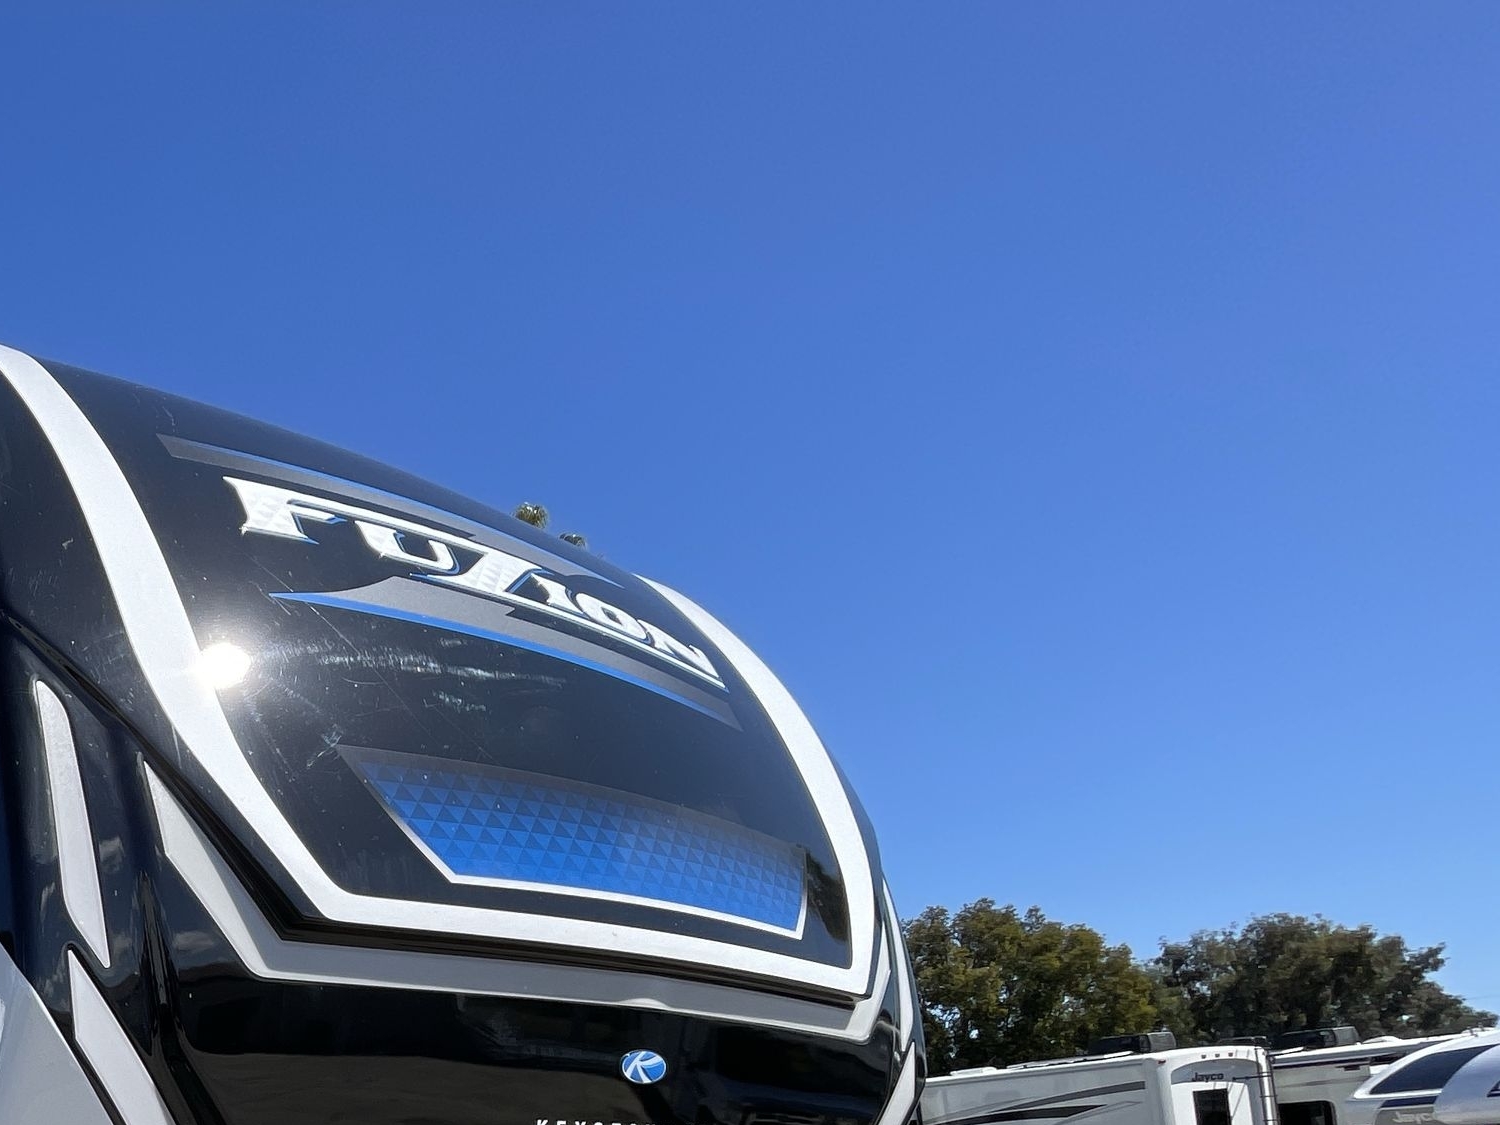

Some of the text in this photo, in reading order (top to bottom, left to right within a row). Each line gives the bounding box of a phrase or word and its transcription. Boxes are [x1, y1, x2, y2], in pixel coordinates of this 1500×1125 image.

[221, 475, 730, 694] FUZION
[1191, 1072, 1225, 1083] Jayco
[1391, 1111, 1434, 1124] Jayc
